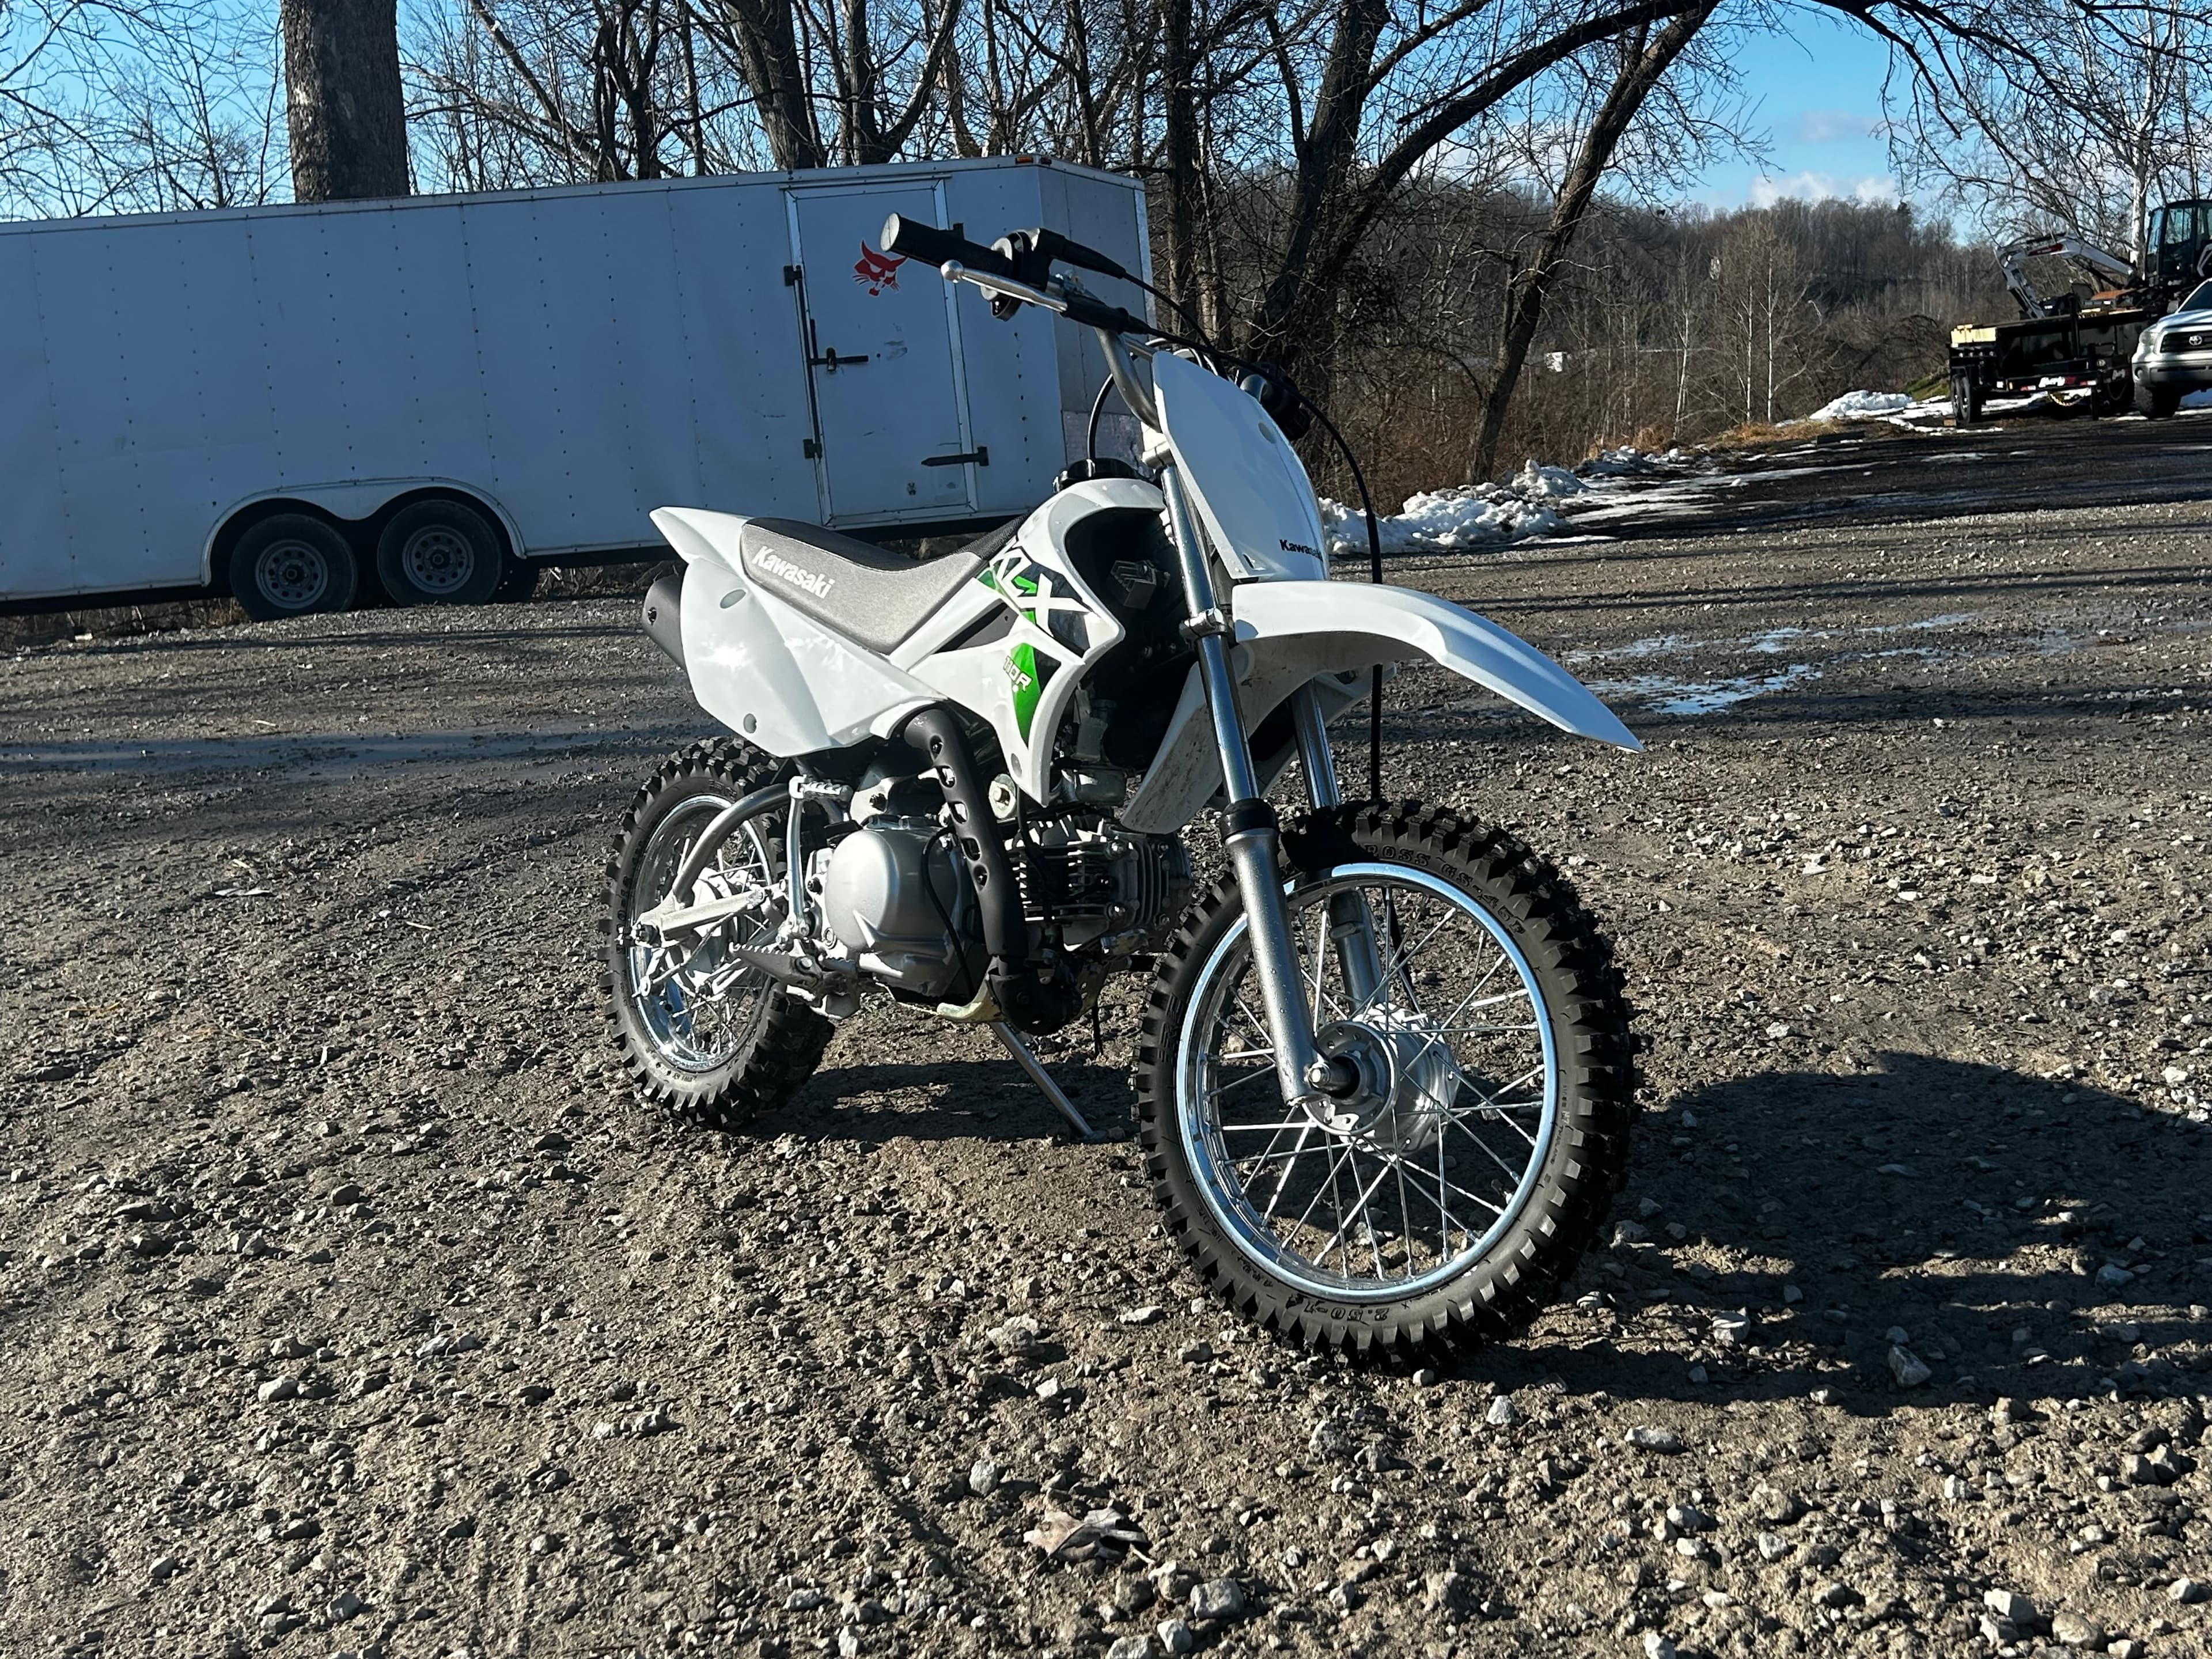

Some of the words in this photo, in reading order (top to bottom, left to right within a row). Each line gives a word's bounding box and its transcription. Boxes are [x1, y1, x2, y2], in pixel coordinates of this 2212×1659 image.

[752, 546, 835, 599] Kawasaki
[990, 536, 1090, 637] KLX
[1003, 656, 1033, 692] 110R
